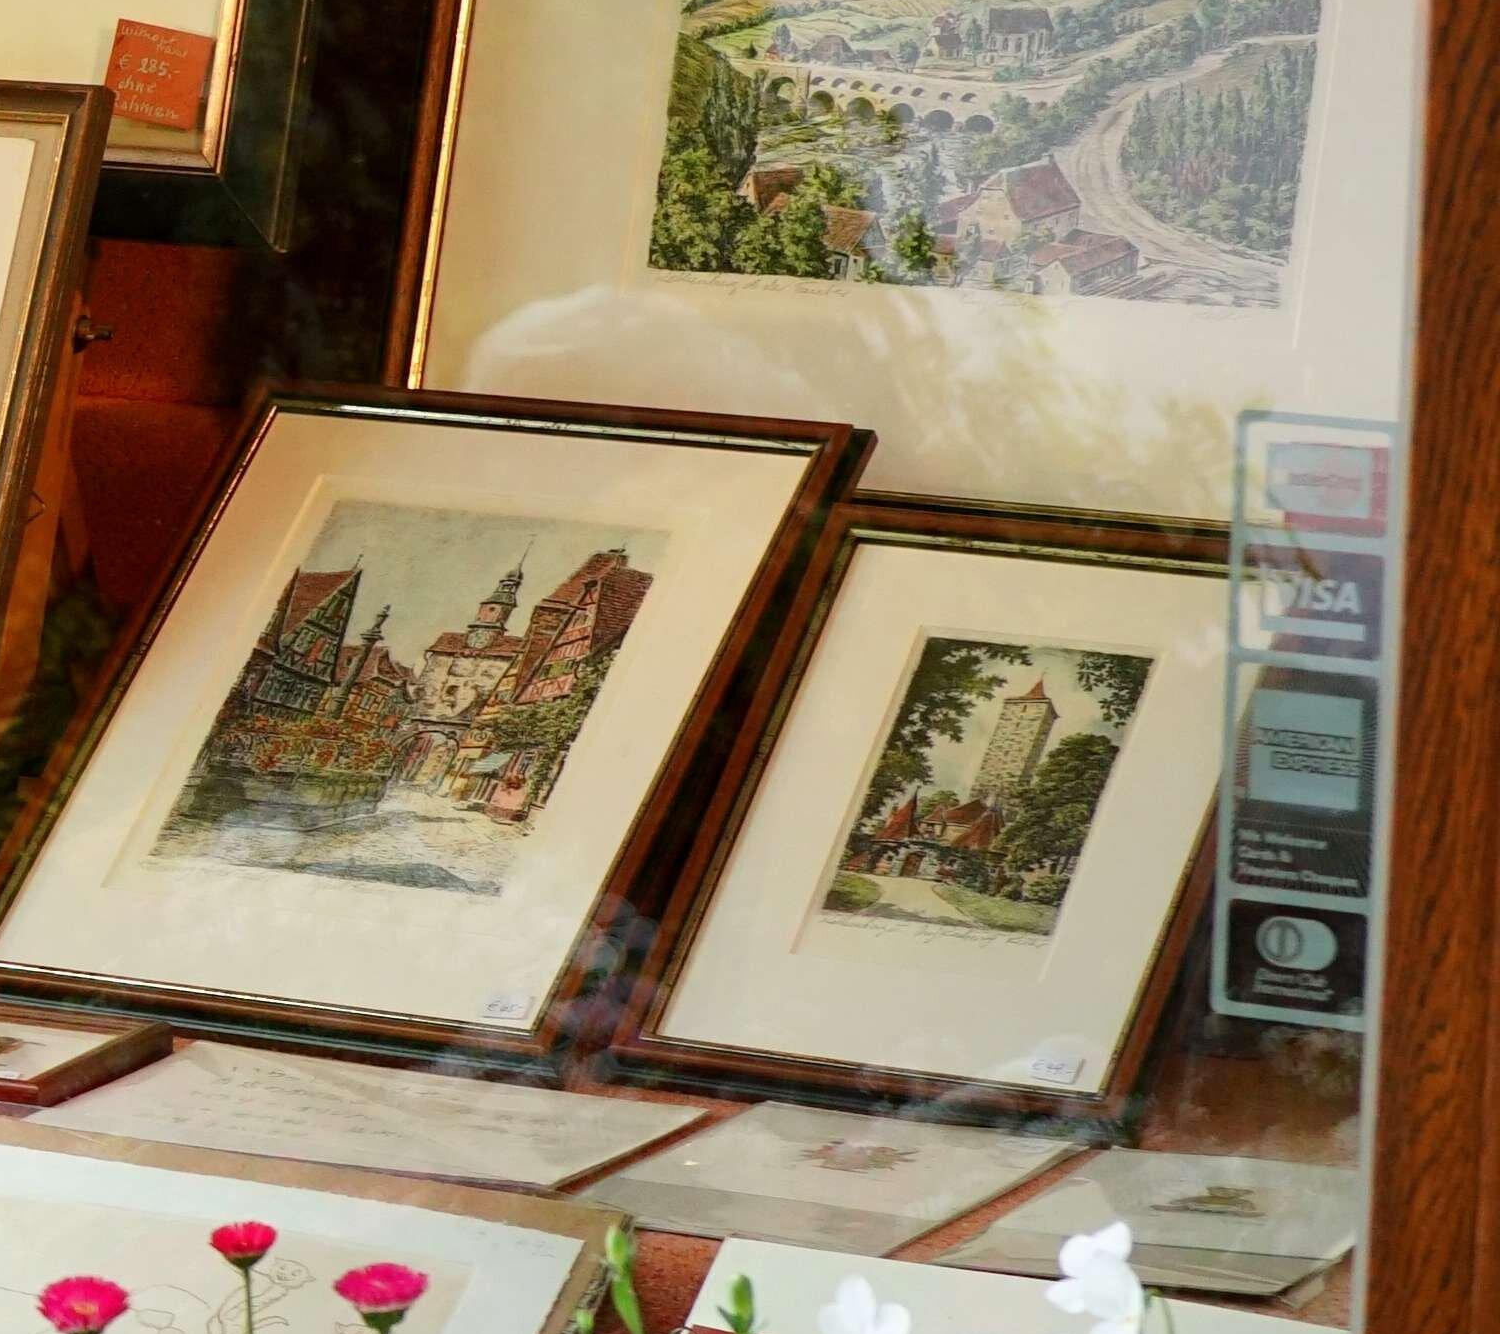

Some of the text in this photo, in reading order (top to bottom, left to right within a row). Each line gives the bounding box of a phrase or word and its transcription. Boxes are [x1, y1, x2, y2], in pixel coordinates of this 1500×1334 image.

[117, 74, 157, 93] ohne
[1261, 567, 1362, 615] VISA
[1252, 727, 1357, 755] AMERICAN
[1270, 750, 1362, 778] EXPRESS
